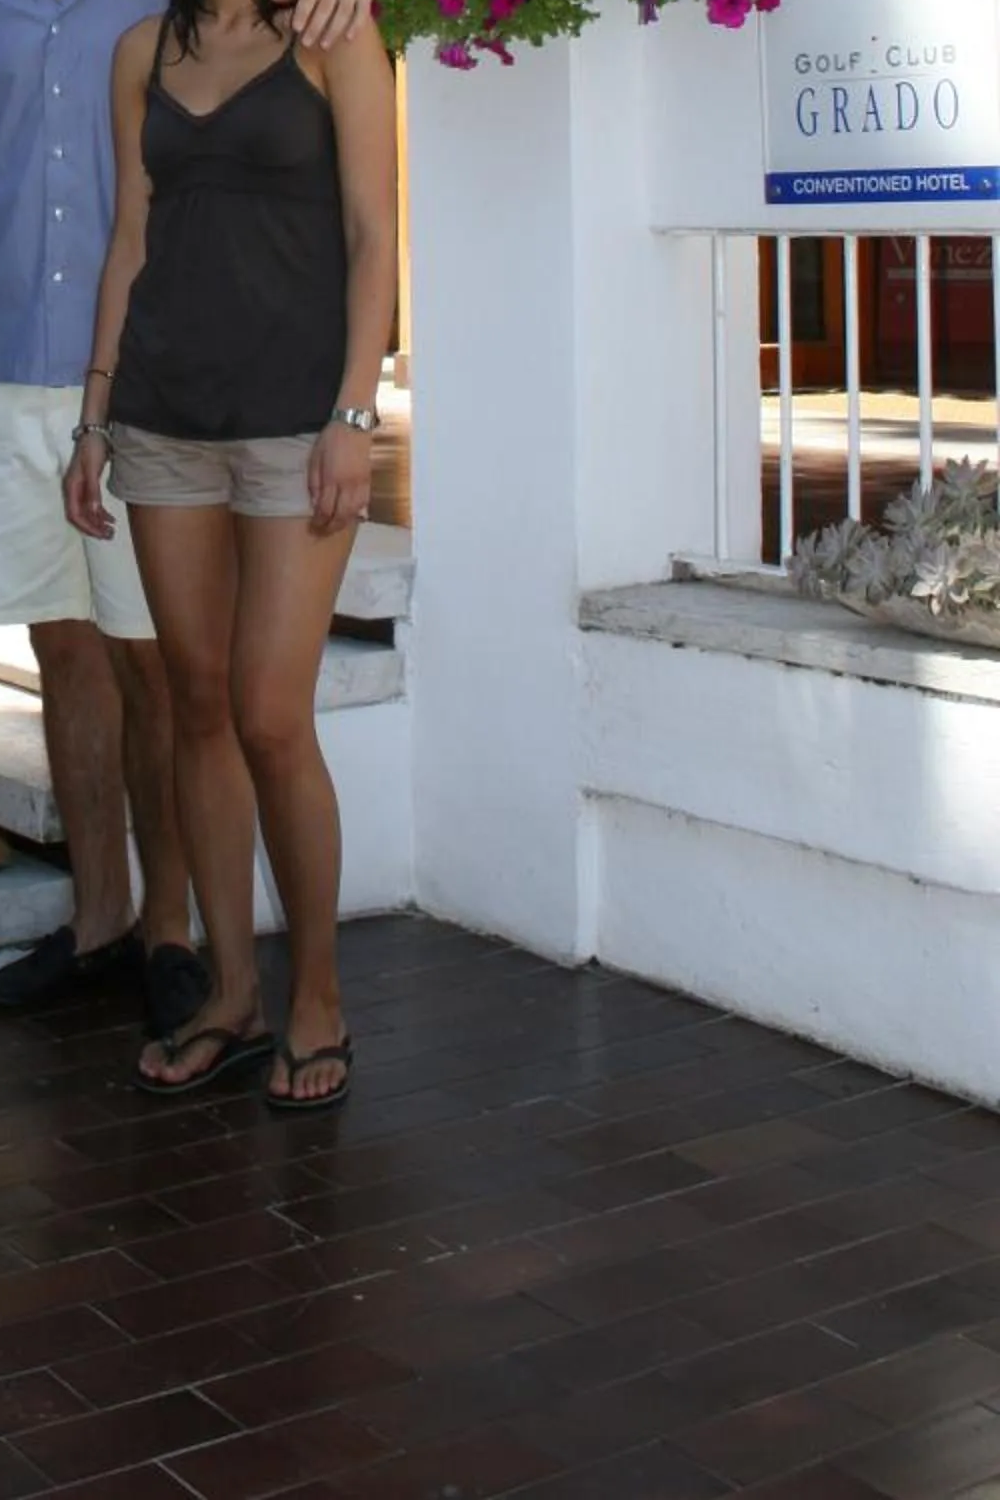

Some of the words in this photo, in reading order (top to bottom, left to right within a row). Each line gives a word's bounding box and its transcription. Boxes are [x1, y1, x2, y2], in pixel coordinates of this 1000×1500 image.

[794, 51, 861, 75] GOLF
[885, 44, 957, 67] CLUB
[795, 77, 959, 137] GRADO
[792, 177, 913, 195] CONVENTIONED
[915, 173, 971, 192] HOTEL
